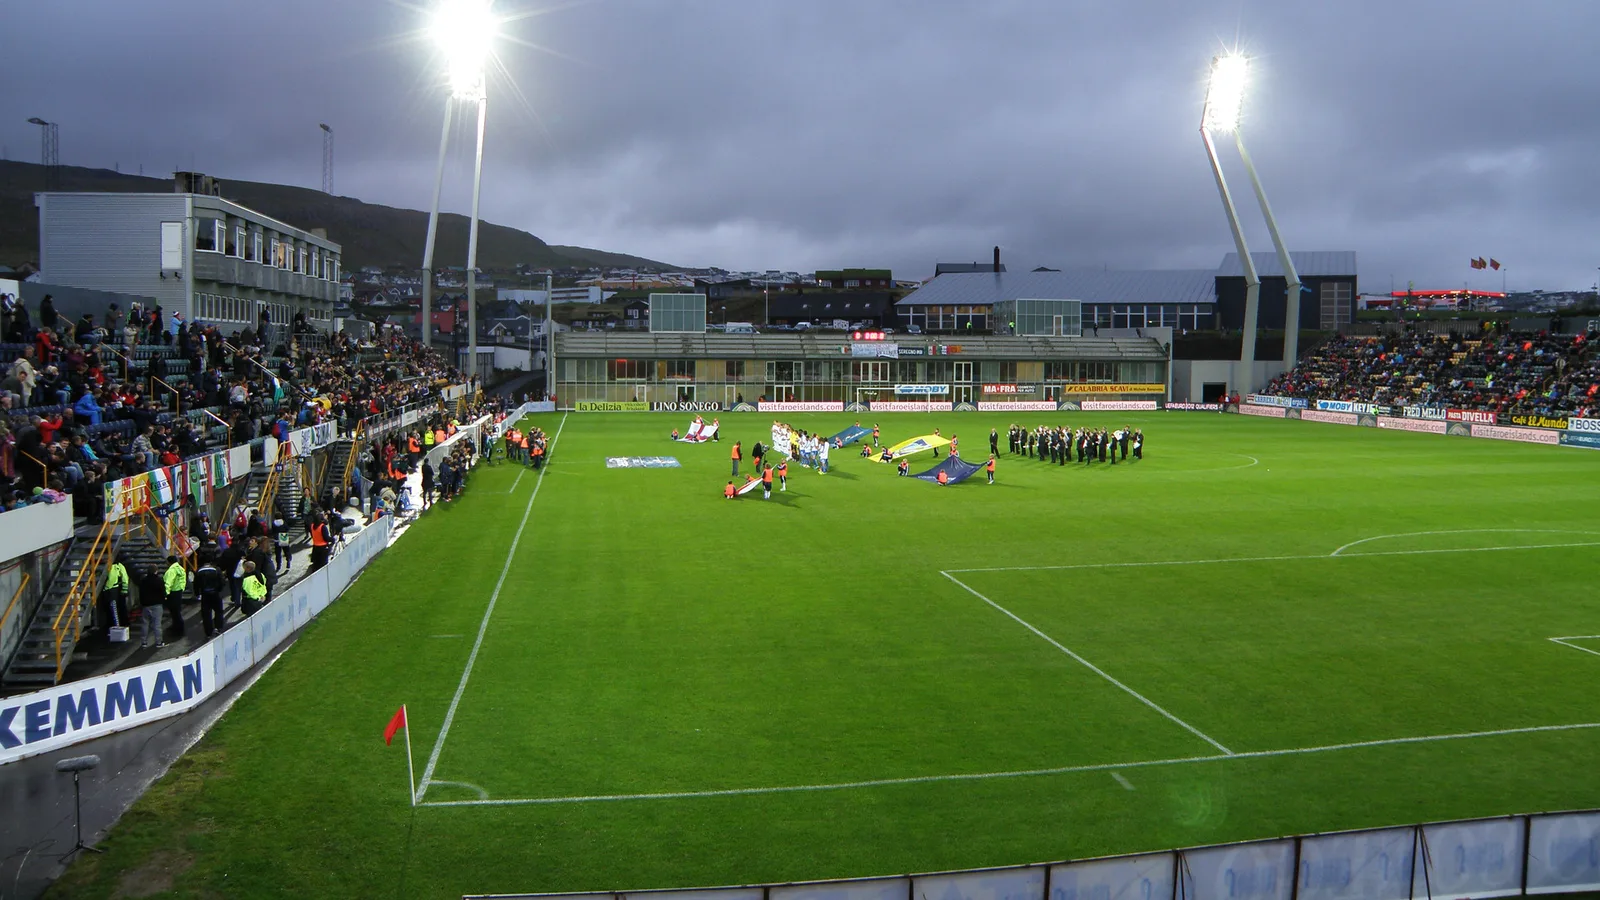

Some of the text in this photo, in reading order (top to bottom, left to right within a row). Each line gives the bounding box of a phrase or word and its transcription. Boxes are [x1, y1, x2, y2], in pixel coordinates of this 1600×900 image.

[914, 385, 948, 393] MOBY
[579, 402, 622, 411] la Delizia
[653, 402, 720, 411] LINO SONEGO
[759, 403, 842, 411] visitfaroeislands.com
[979, 403, 1056, 411] visitfaroeislands.com
[1083, 402, 1156, 410] visitfaroeislands.com
[1328, 401, 1352, 411] MOBY
[1353, 403, 1367, 413] KEY
[1402, 406, 1421, 417] FRED
[1421, 407, 1447, 420] MELLO
[1447, 411, 1494, 423] PASTA DIVELLA
[1536, 418, 1568, 430] Mundo
[1472, 426, 1558, 444] visitfaroeislands.com
